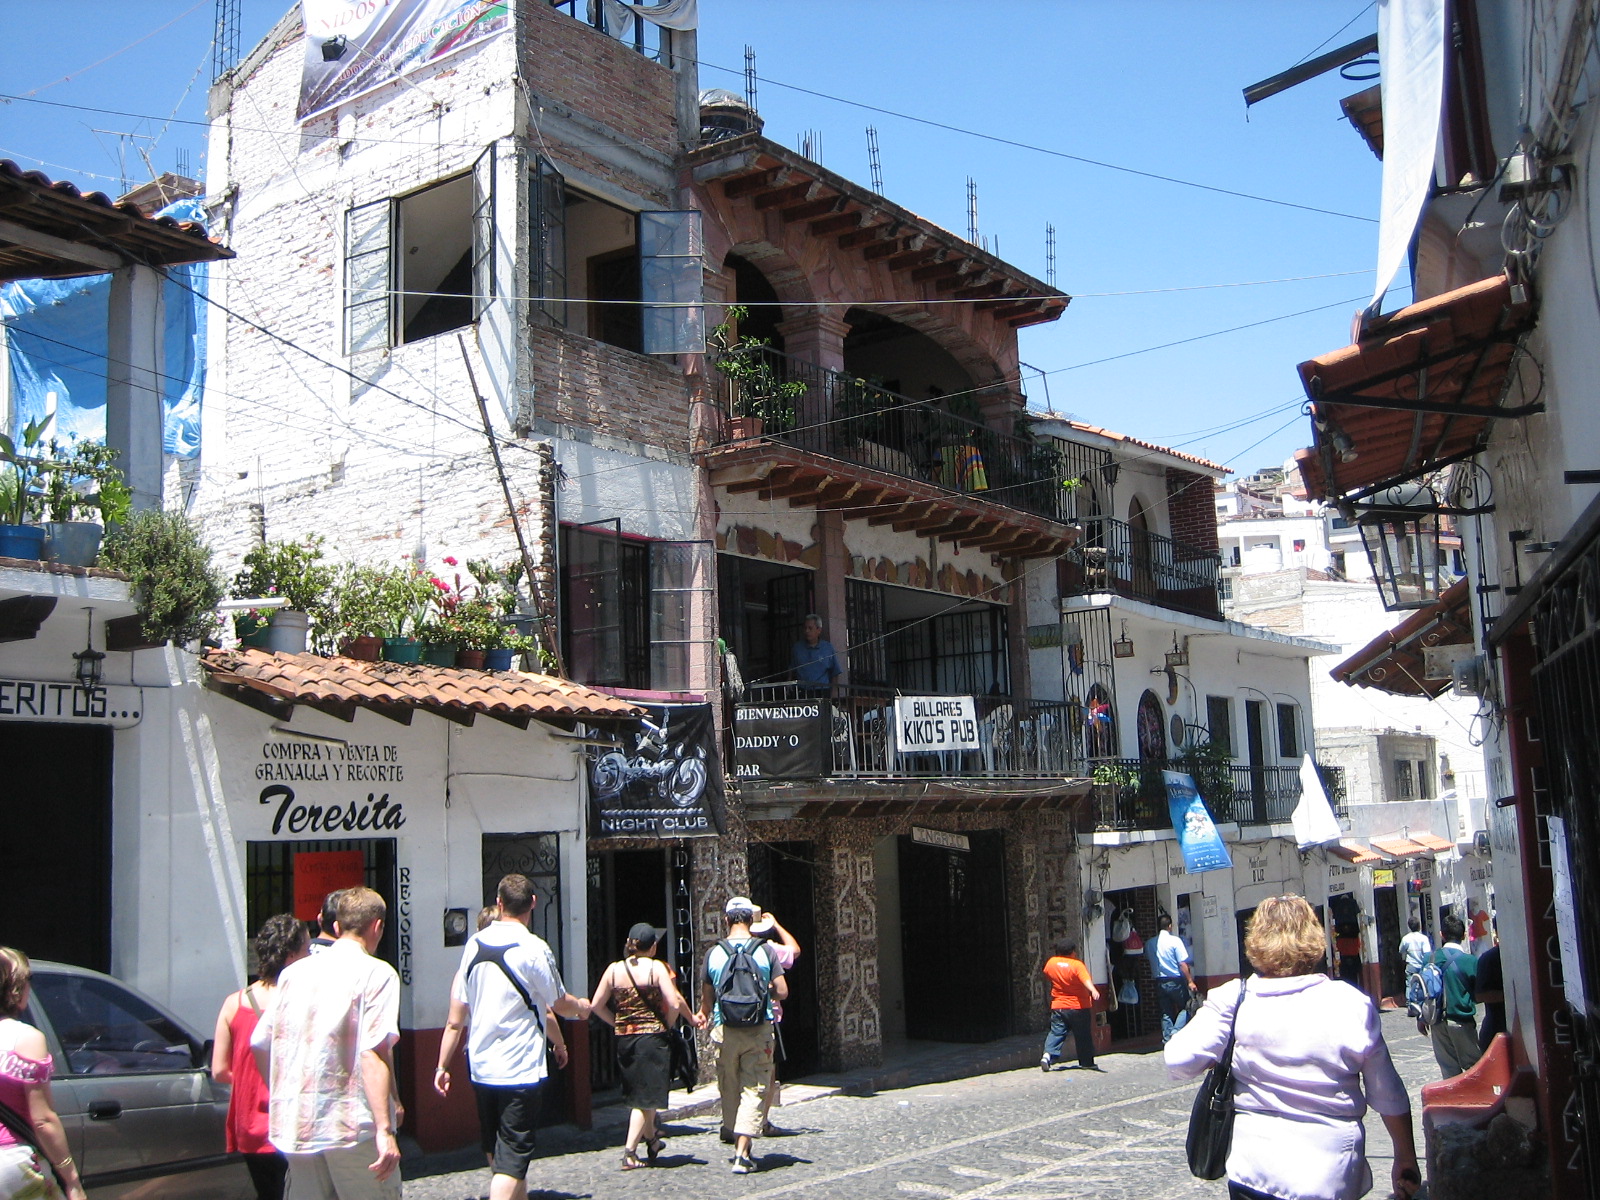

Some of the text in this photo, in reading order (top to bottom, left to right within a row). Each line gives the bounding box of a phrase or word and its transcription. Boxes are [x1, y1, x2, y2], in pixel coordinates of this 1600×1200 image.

[736, 705, 819, 721] BIENVENIDOS
[913, 702, 963, 718] BILLARES
[903, 720, 975, 745] KIKO'S PUB
[262, 743, 398, 763] COMPRA Y VENTA DE
[255, 763, 404, 782] GRANALLA Y RECORTE
[736, 763, 761, 777] BAR
[259, 784, 406, 835] Teresita
[601, 816, 709, 832] NIGHT CLUB
[399, 867, 413, 985] RECORTE
